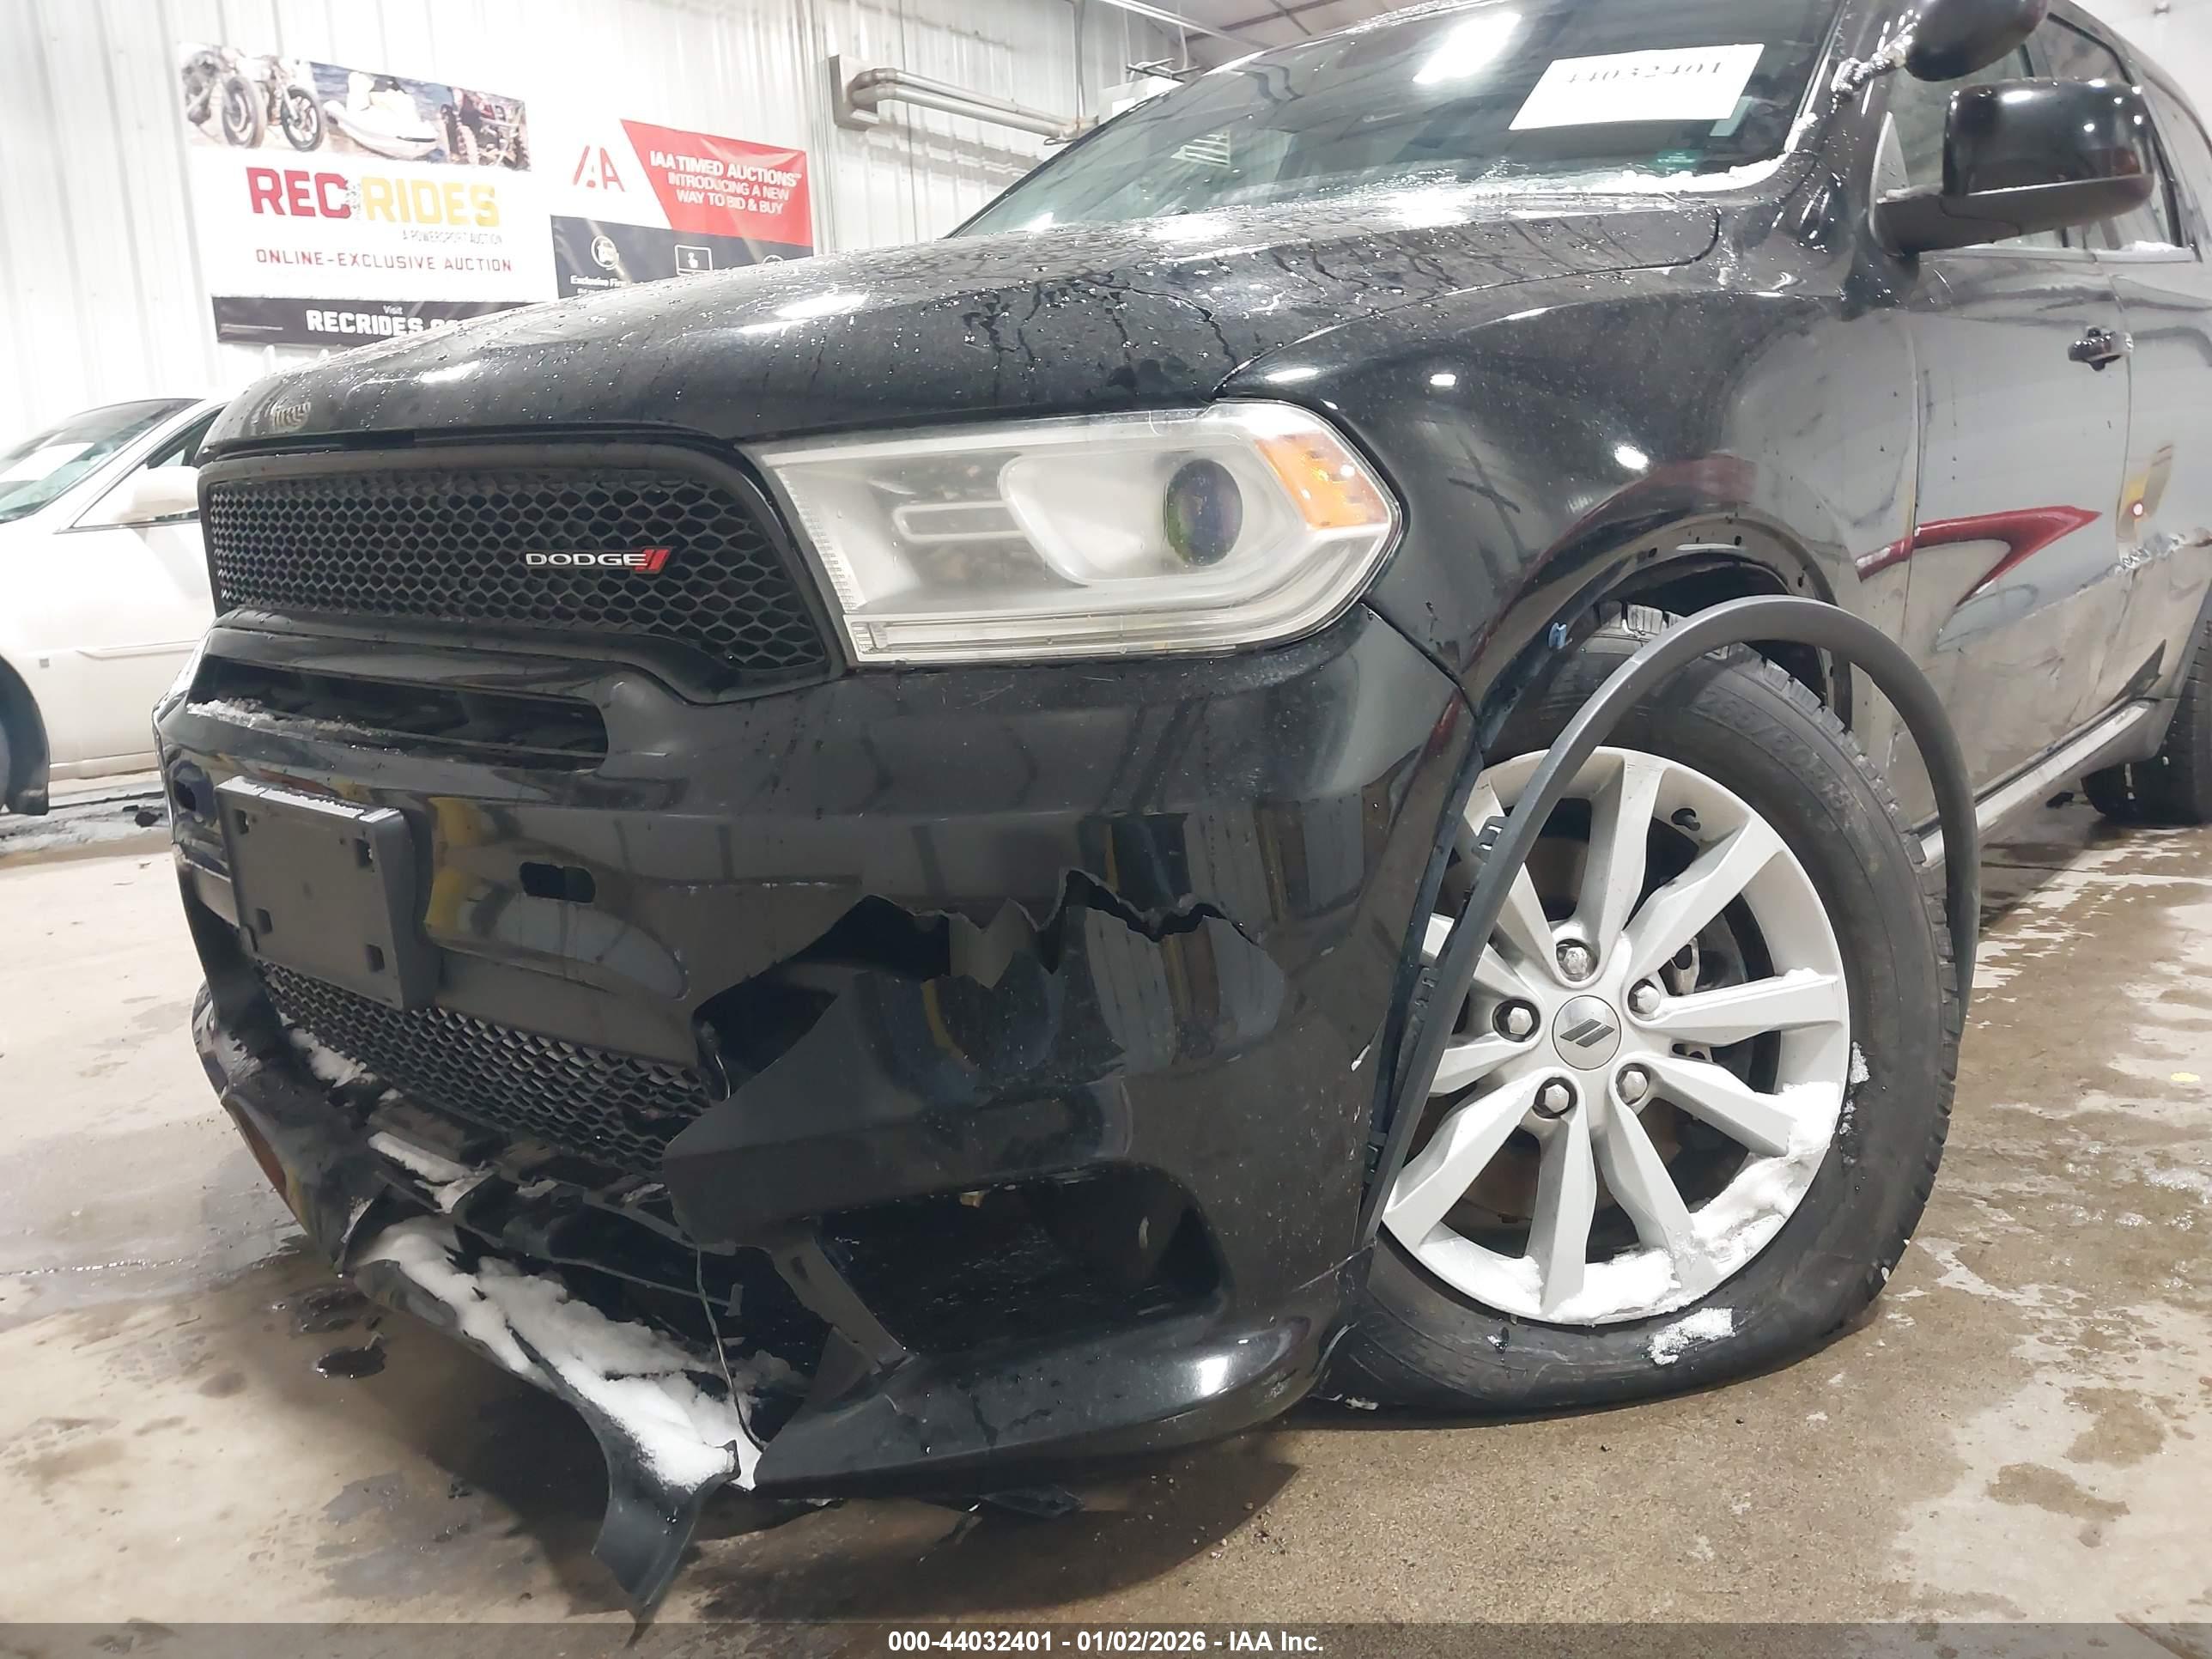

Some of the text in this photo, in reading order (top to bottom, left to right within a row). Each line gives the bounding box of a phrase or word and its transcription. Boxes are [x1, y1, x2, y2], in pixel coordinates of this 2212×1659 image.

[649, 150, 676, 170] IAA
[676, 155, 724, 177] TIMED
[246, 167, 500, 228] REC RIDES
[668, 172, 789, 201] INTRODUCING A NEW
[677, 189, 783, 215] WAY TO BID & BUY
[256, 249, 512, 272] ONLINE-EXCLUSIVE AUCTION
[526, 552, 648, 567] DODGE
